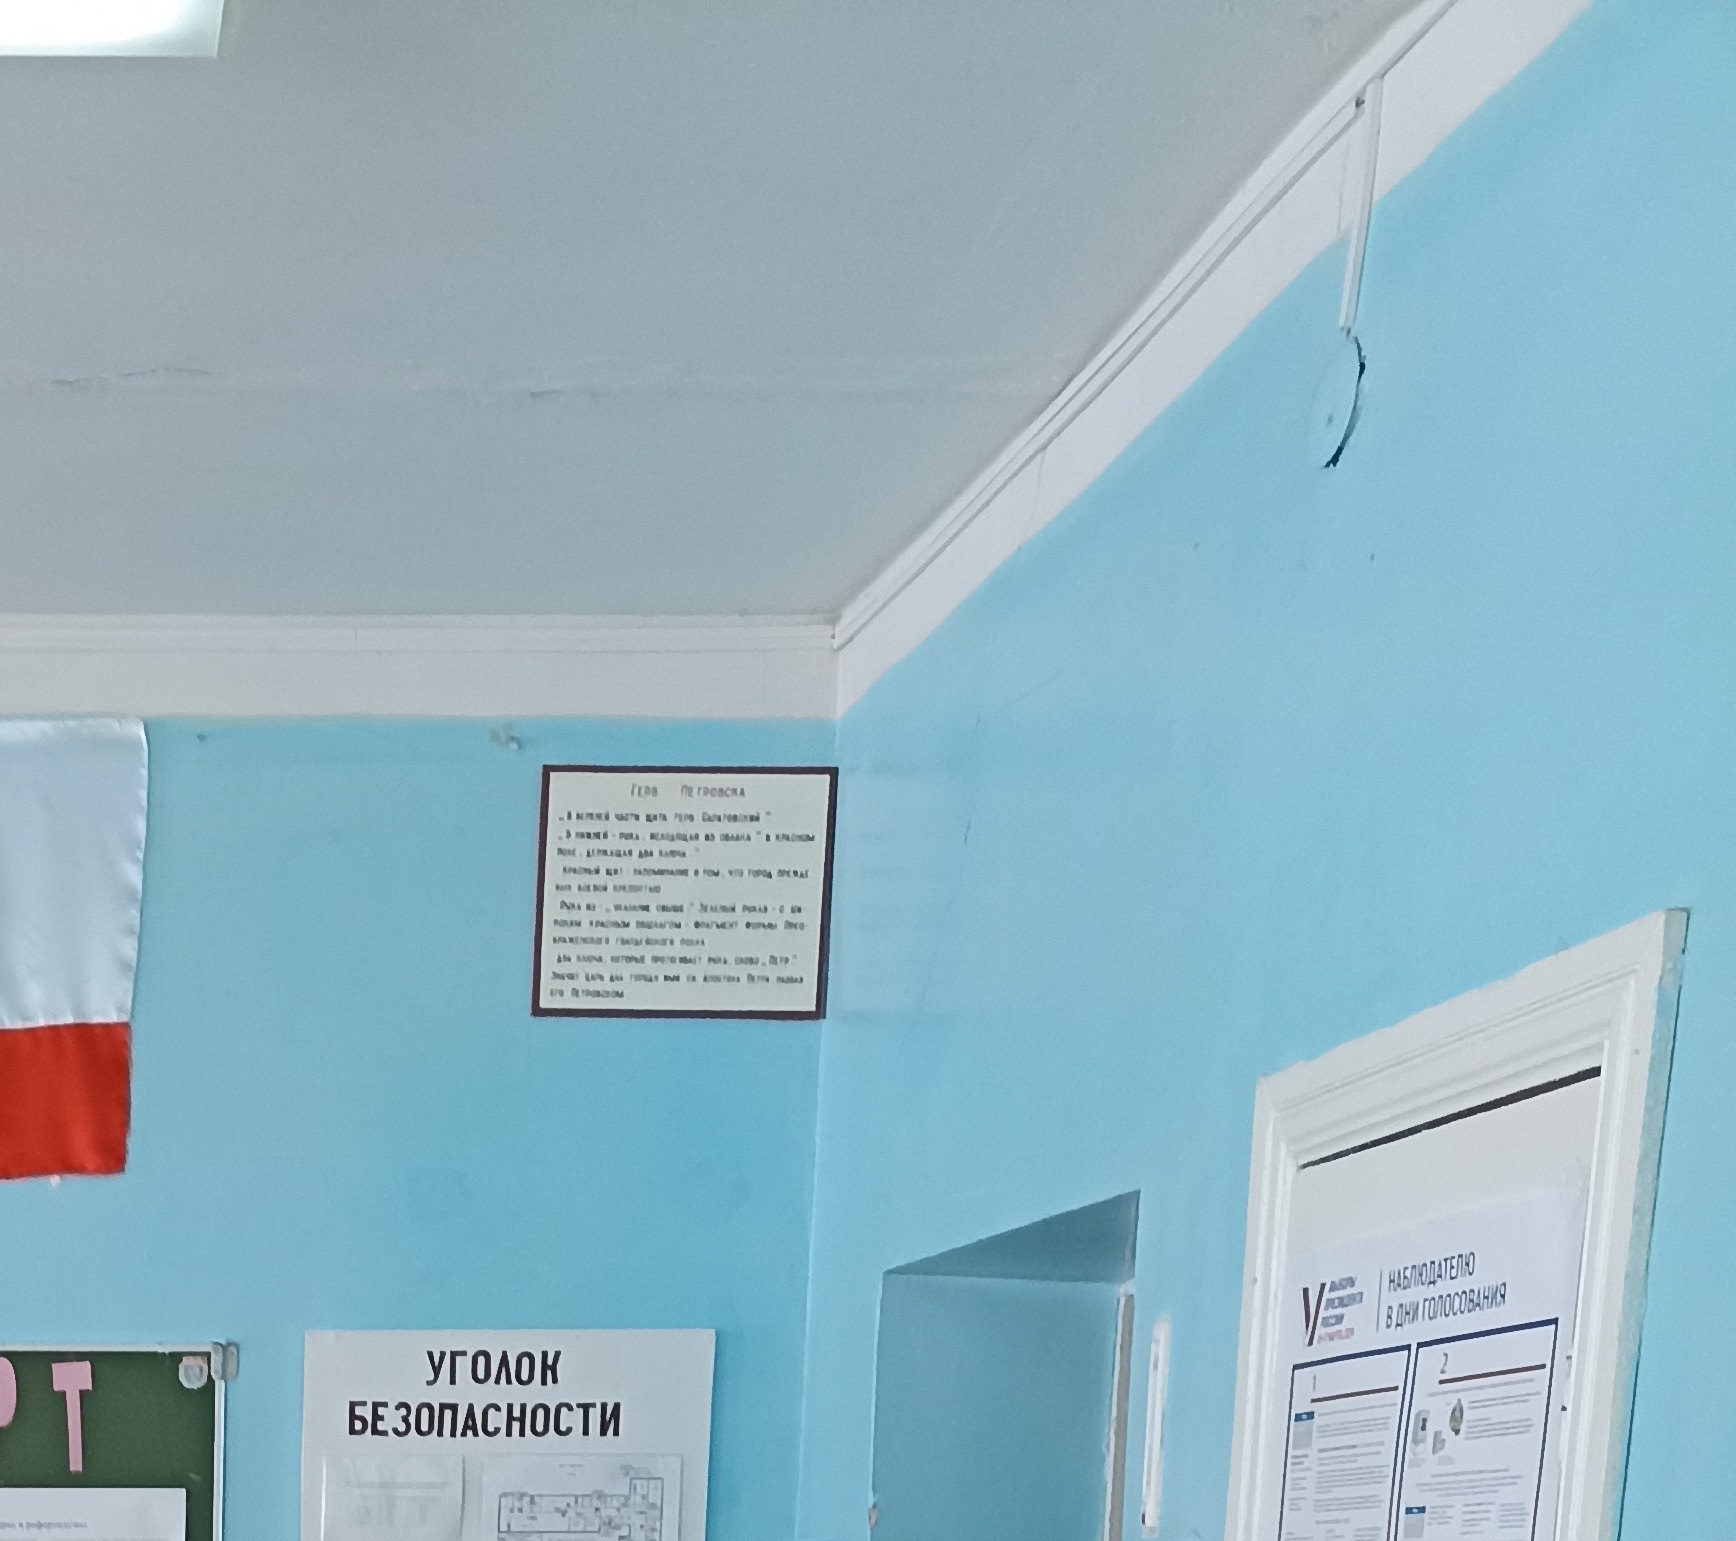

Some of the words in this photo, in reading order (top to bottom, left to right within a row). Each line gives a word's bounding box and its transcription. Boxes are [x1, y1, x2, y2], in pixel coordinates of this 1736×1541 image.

[1387, 1251, 1476, 1292] НАБЛЮДАТЕЛЮ
[1385, 1305, 1393, 1330] В
[1395, 1300, 1420, 1330] ДНИ
[1421, 1281, 1507, 1323] ГОЛОСОВАНИЯ
[426, 1349, 562, 1387] УГОЛОК
[1439, 1352, 1449, 1375] 2
[347, 1400, 622, 1438] БЕЗОПАСНОСТИ
